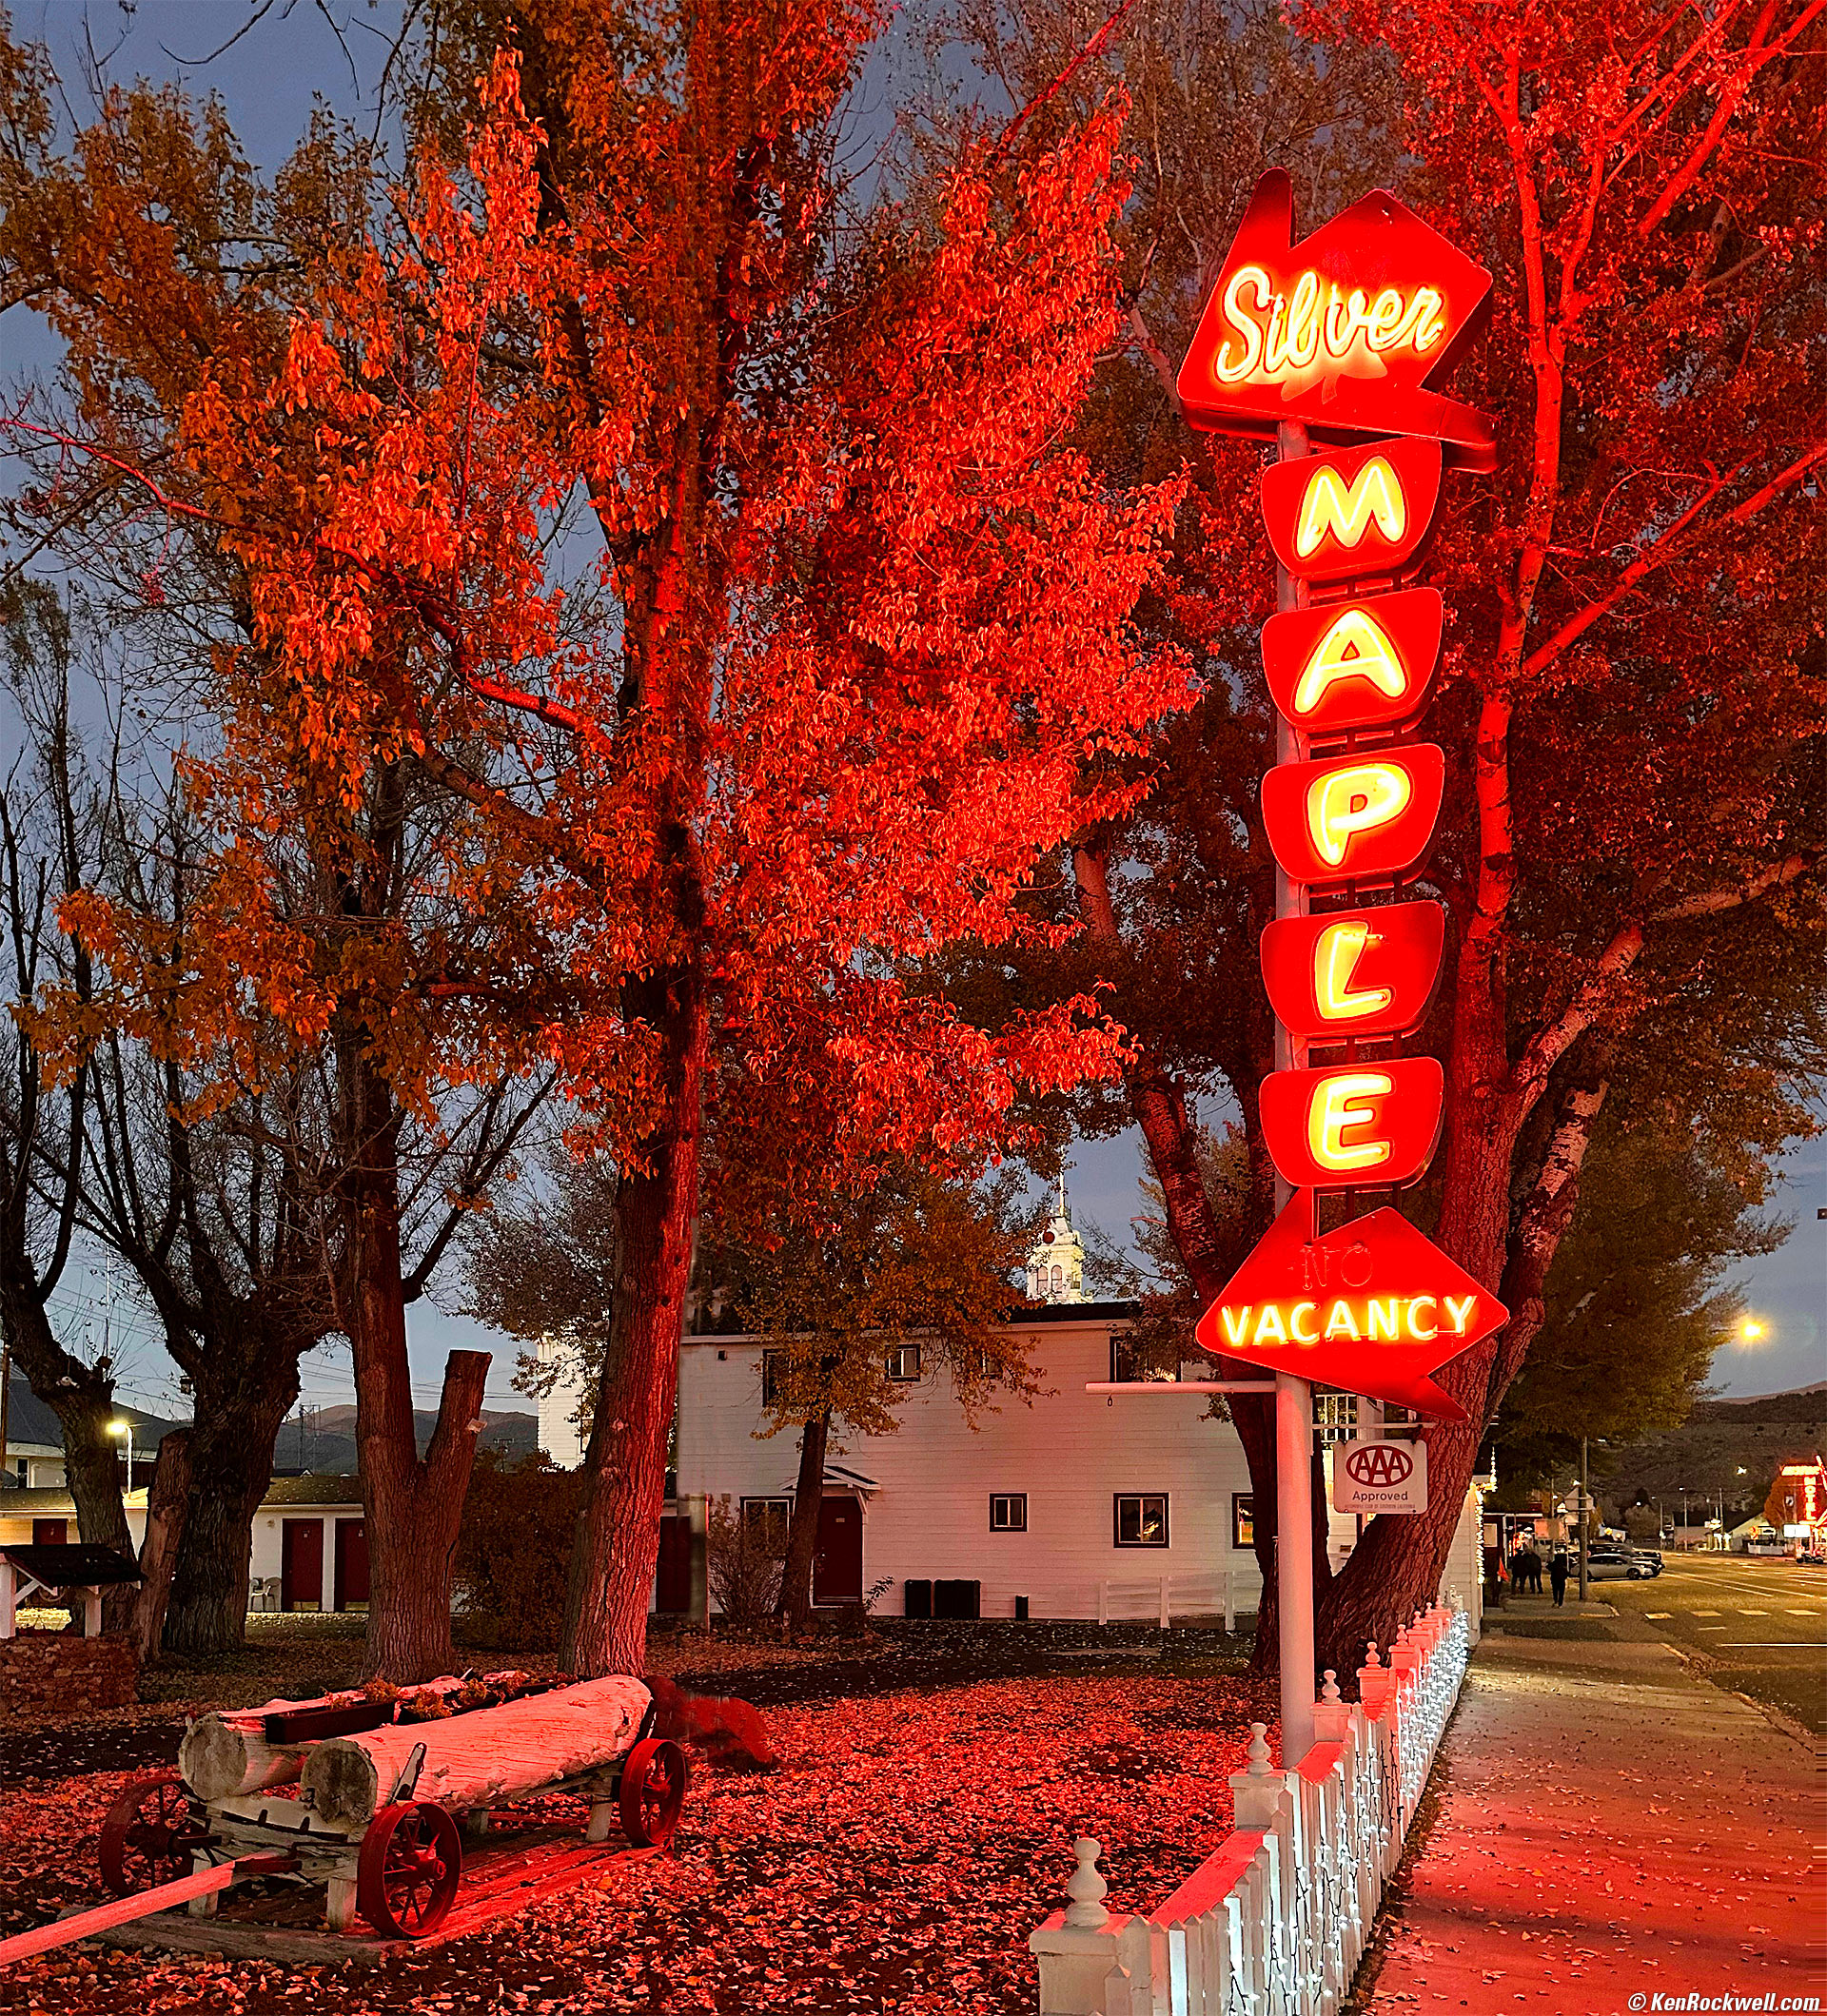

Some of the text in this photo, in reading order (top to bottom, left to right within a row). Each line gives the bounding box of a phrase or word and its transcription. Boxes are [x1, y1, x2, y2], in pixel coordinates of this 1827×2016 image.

[1214, 266, 1446, 383] Silver
[1293, 456, 1411, 1170] MAPLE
[1301, 1243, 1373, 1290] NO
[1221, 1295, 1478, 1346] VACANCY
[1351, 1446, 1407, 1486] AAA
[1352, 1491, 1408, 1502] Approved
[1803, 1476, 1817, 1520] MOTEL
